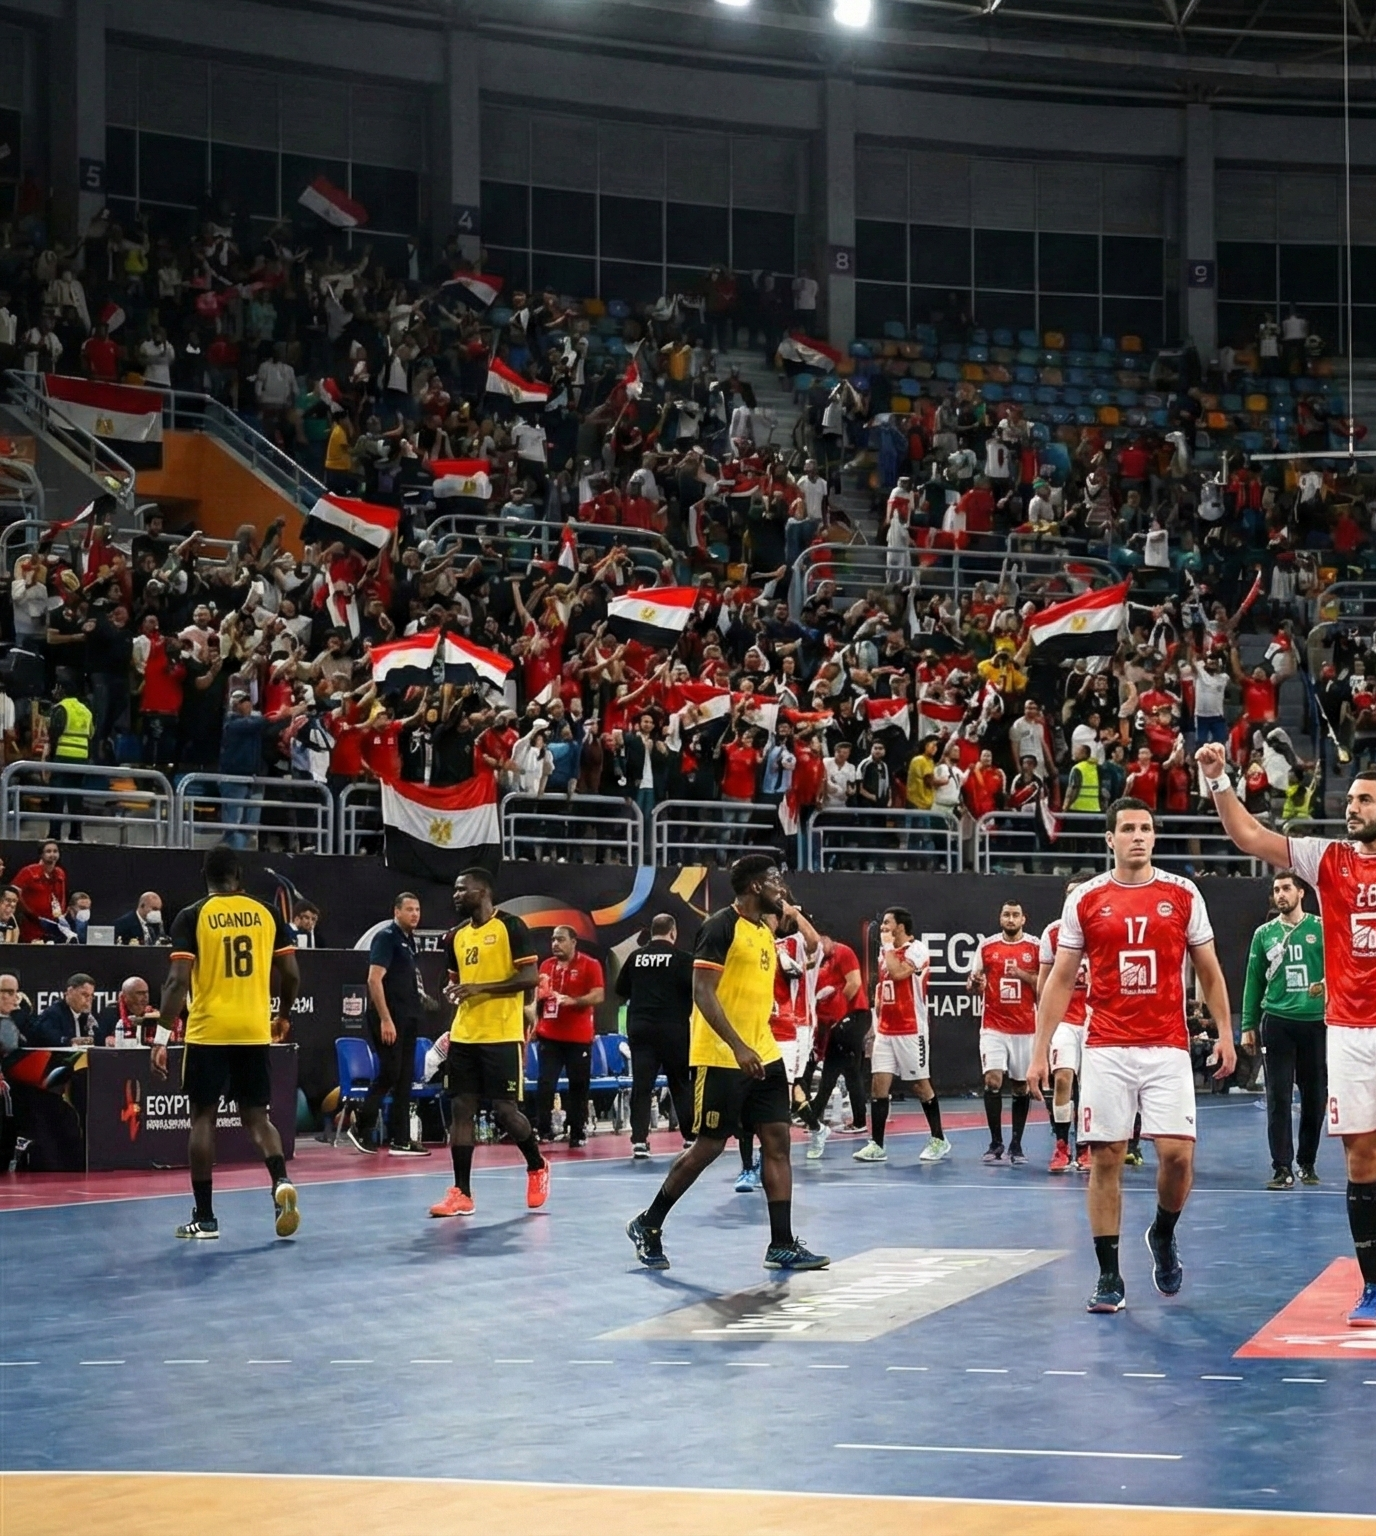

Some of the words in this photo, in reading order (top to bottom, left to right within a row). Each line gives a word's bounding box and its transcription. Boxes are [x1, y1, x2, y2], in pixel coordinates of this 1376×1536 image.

[86, 165, 101, 188] 5
[457, 210, 474, 230] 4
[835, 252, 849, 270] 8
[1194, 264, 1208, 283] 9
[1124, 916, 1148, 944] 17
[223, 934, 254, 978] 18
[635, 953, 673, 968] EGYPT
[1287, 944, 1303, 962] 10
